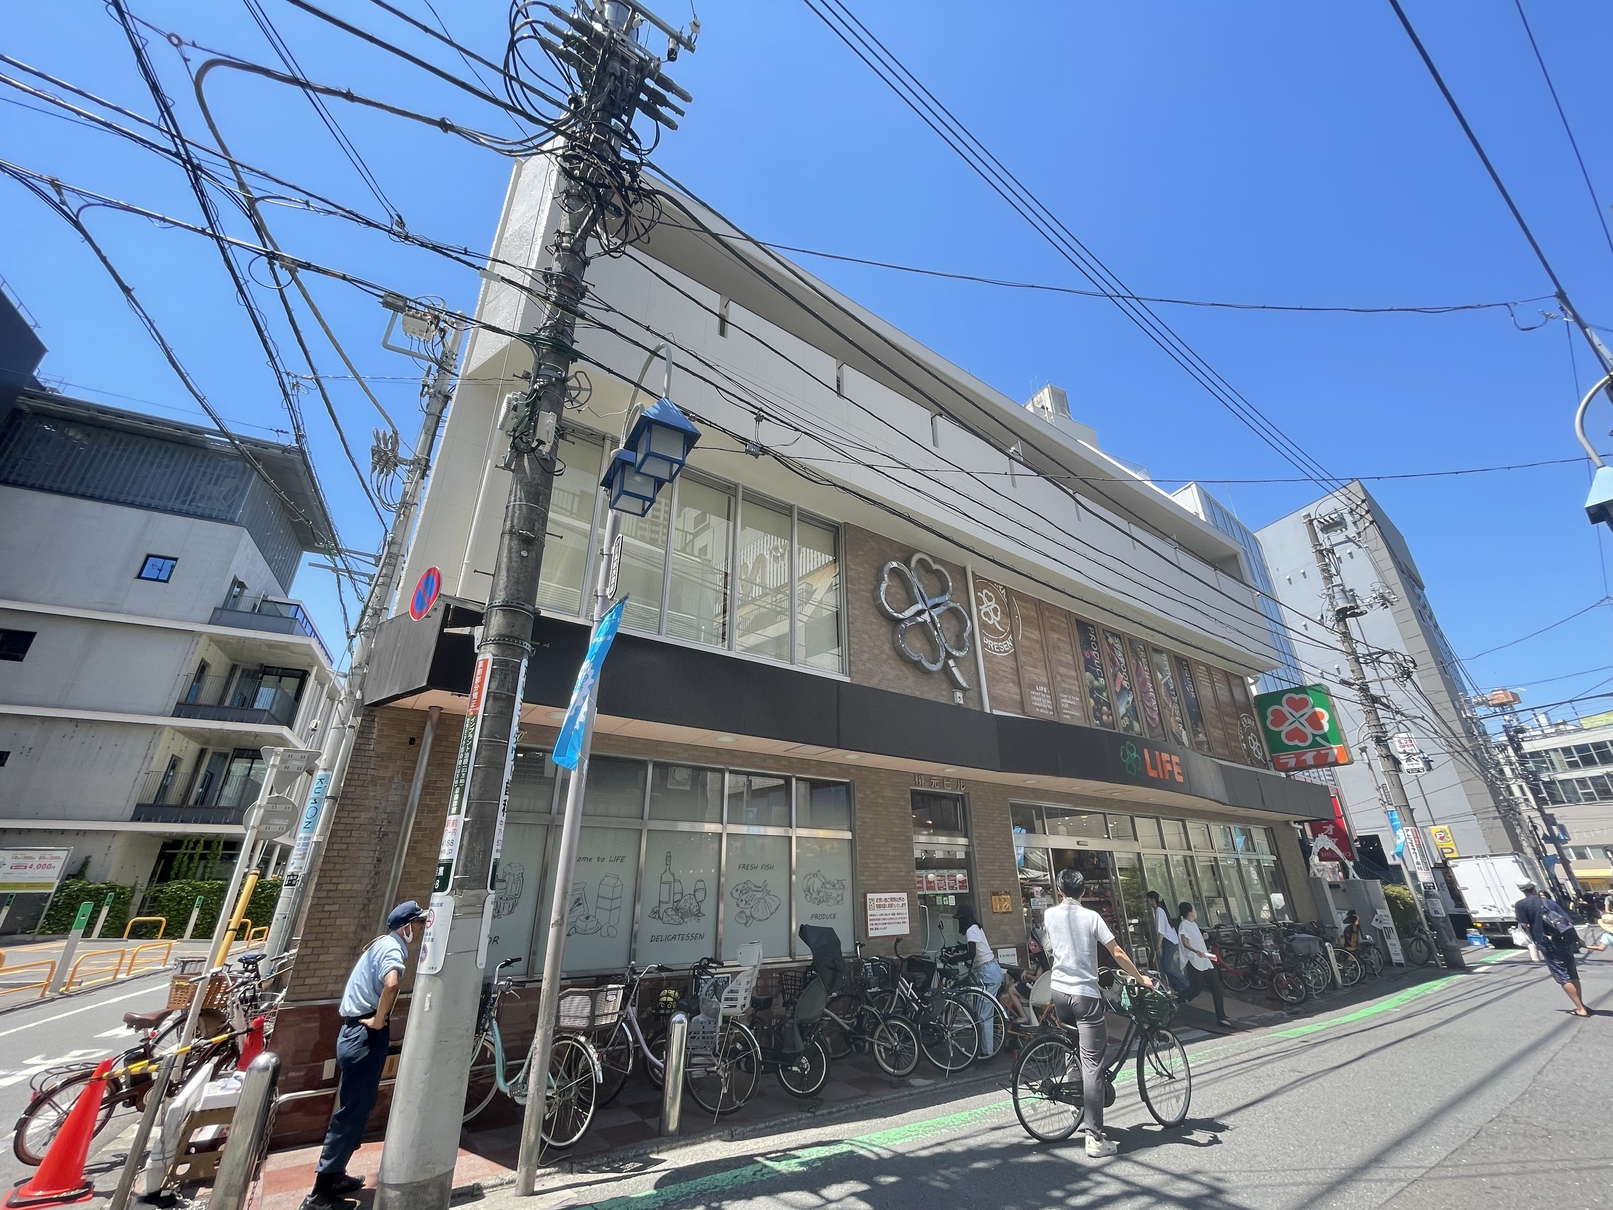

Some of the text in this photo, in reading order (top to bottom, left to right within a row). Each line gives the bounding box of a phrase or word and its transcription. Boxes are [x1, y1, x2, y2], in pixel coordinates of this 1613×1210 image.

[1088, 626, 1105, 685] PRODUCE
[1143, 748, 1183, 783] LIFE
[1279, 748, 1338, 769] ライフ
[609, 855, 627, 863] LIFE
[738, 863, 775, 871] FRESH FISH
[650, 932, 705, 944] DELICATESSEN
